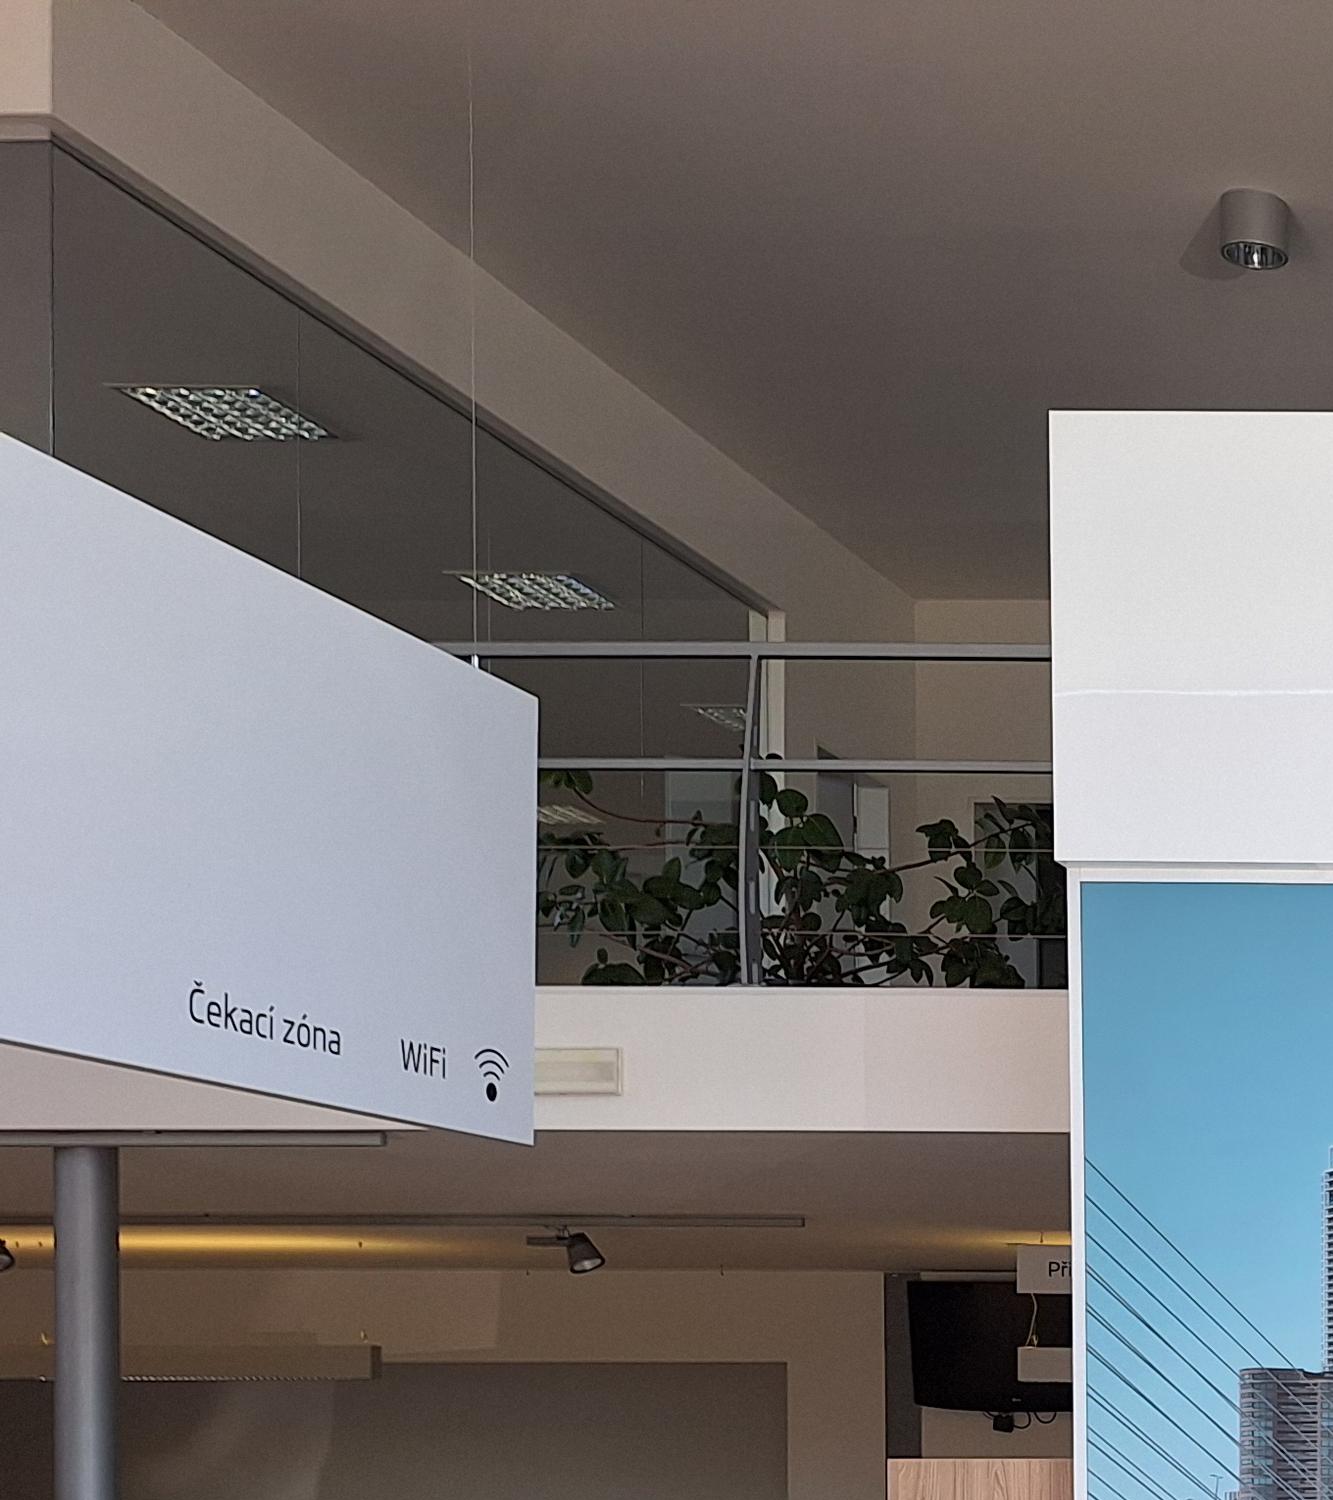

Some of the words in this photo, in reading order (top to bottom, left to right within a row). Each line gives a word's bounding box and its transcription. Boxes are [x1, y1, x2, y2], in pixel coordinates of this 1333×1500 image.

[189, 980, 275, 1040] Čekací
[282, 1013, 341, 1056] zóna
[400, 1038, 446, 1079] WiFi
